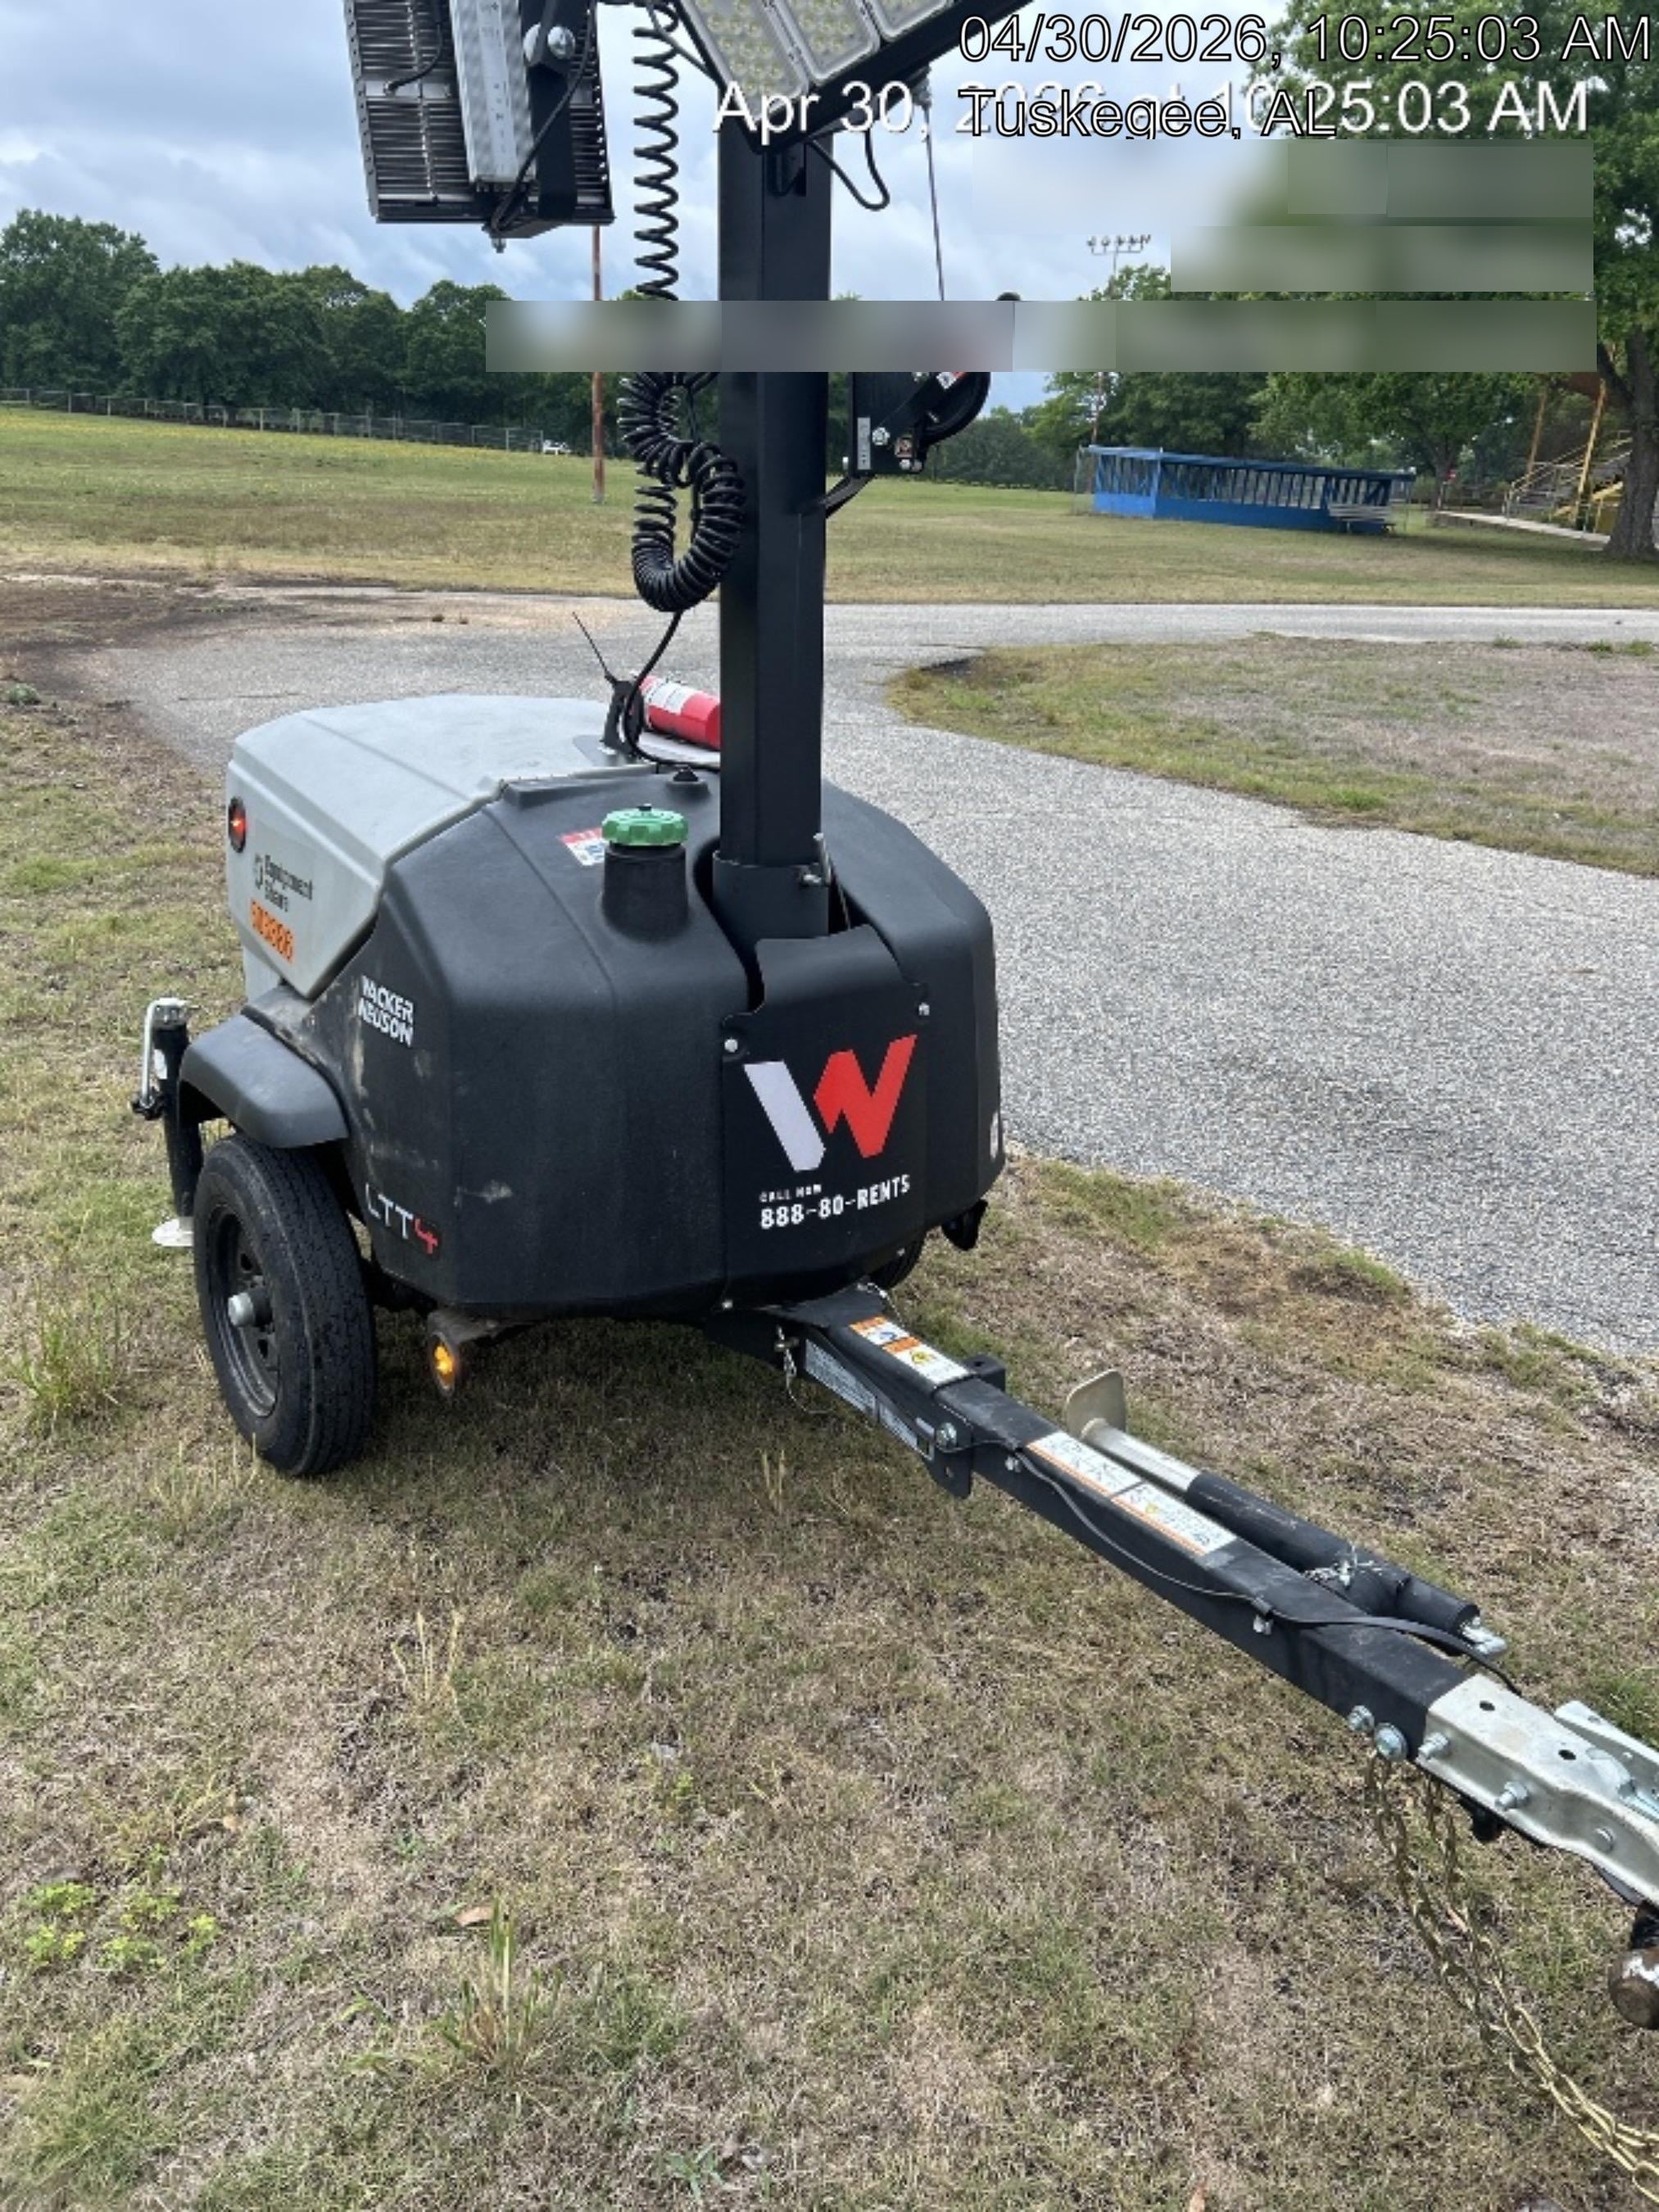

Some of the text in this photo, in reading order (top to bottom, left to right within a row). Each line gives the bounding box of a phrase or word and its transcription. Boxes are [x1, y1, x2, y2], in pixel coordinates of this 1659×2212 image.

[358, 997, 415, 1047] NEUSON
[360, 974, 415, 1018] WACKER
[365, 1181, 439, 1254] LTT4
[760, 1174, 911, 1229] 888-80-RENTS
